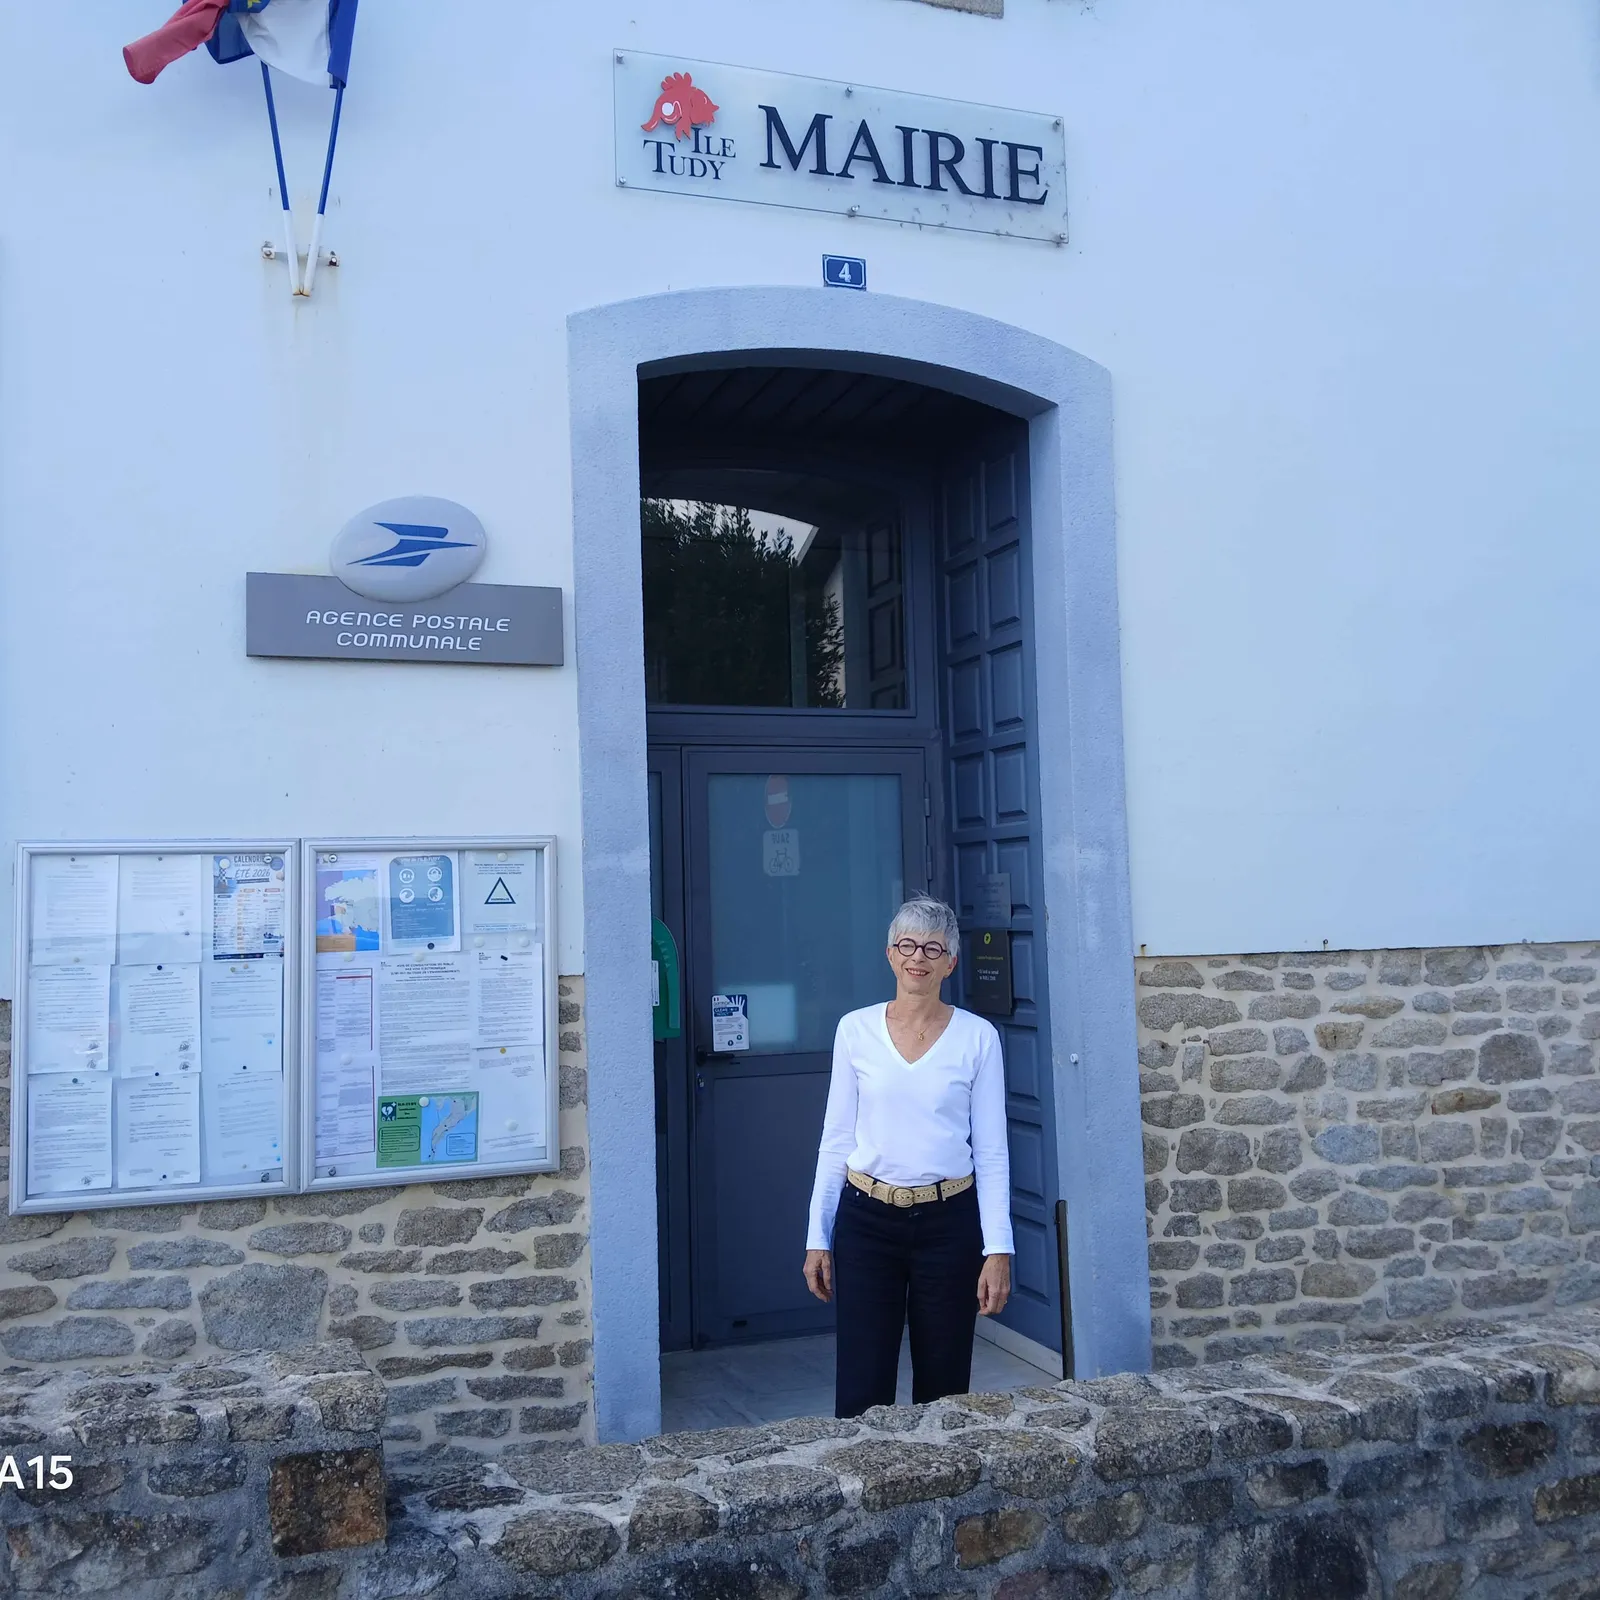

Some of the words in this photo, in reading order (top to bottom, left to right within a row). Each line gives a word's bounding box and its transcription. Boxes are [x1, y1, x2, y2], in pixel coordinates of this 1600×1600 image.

[690, 126, 736, 158] ILE
[757, 104, 1049, 206] MAIRIE
[643, 139, 726, 180] TUDY
[838, 262, 852, 283] 4
[306, 610, 404, 628] AGENCE
[412, 614, 511, 632] POSTALE
[336, 632, 482, 651] COMMUNALE
